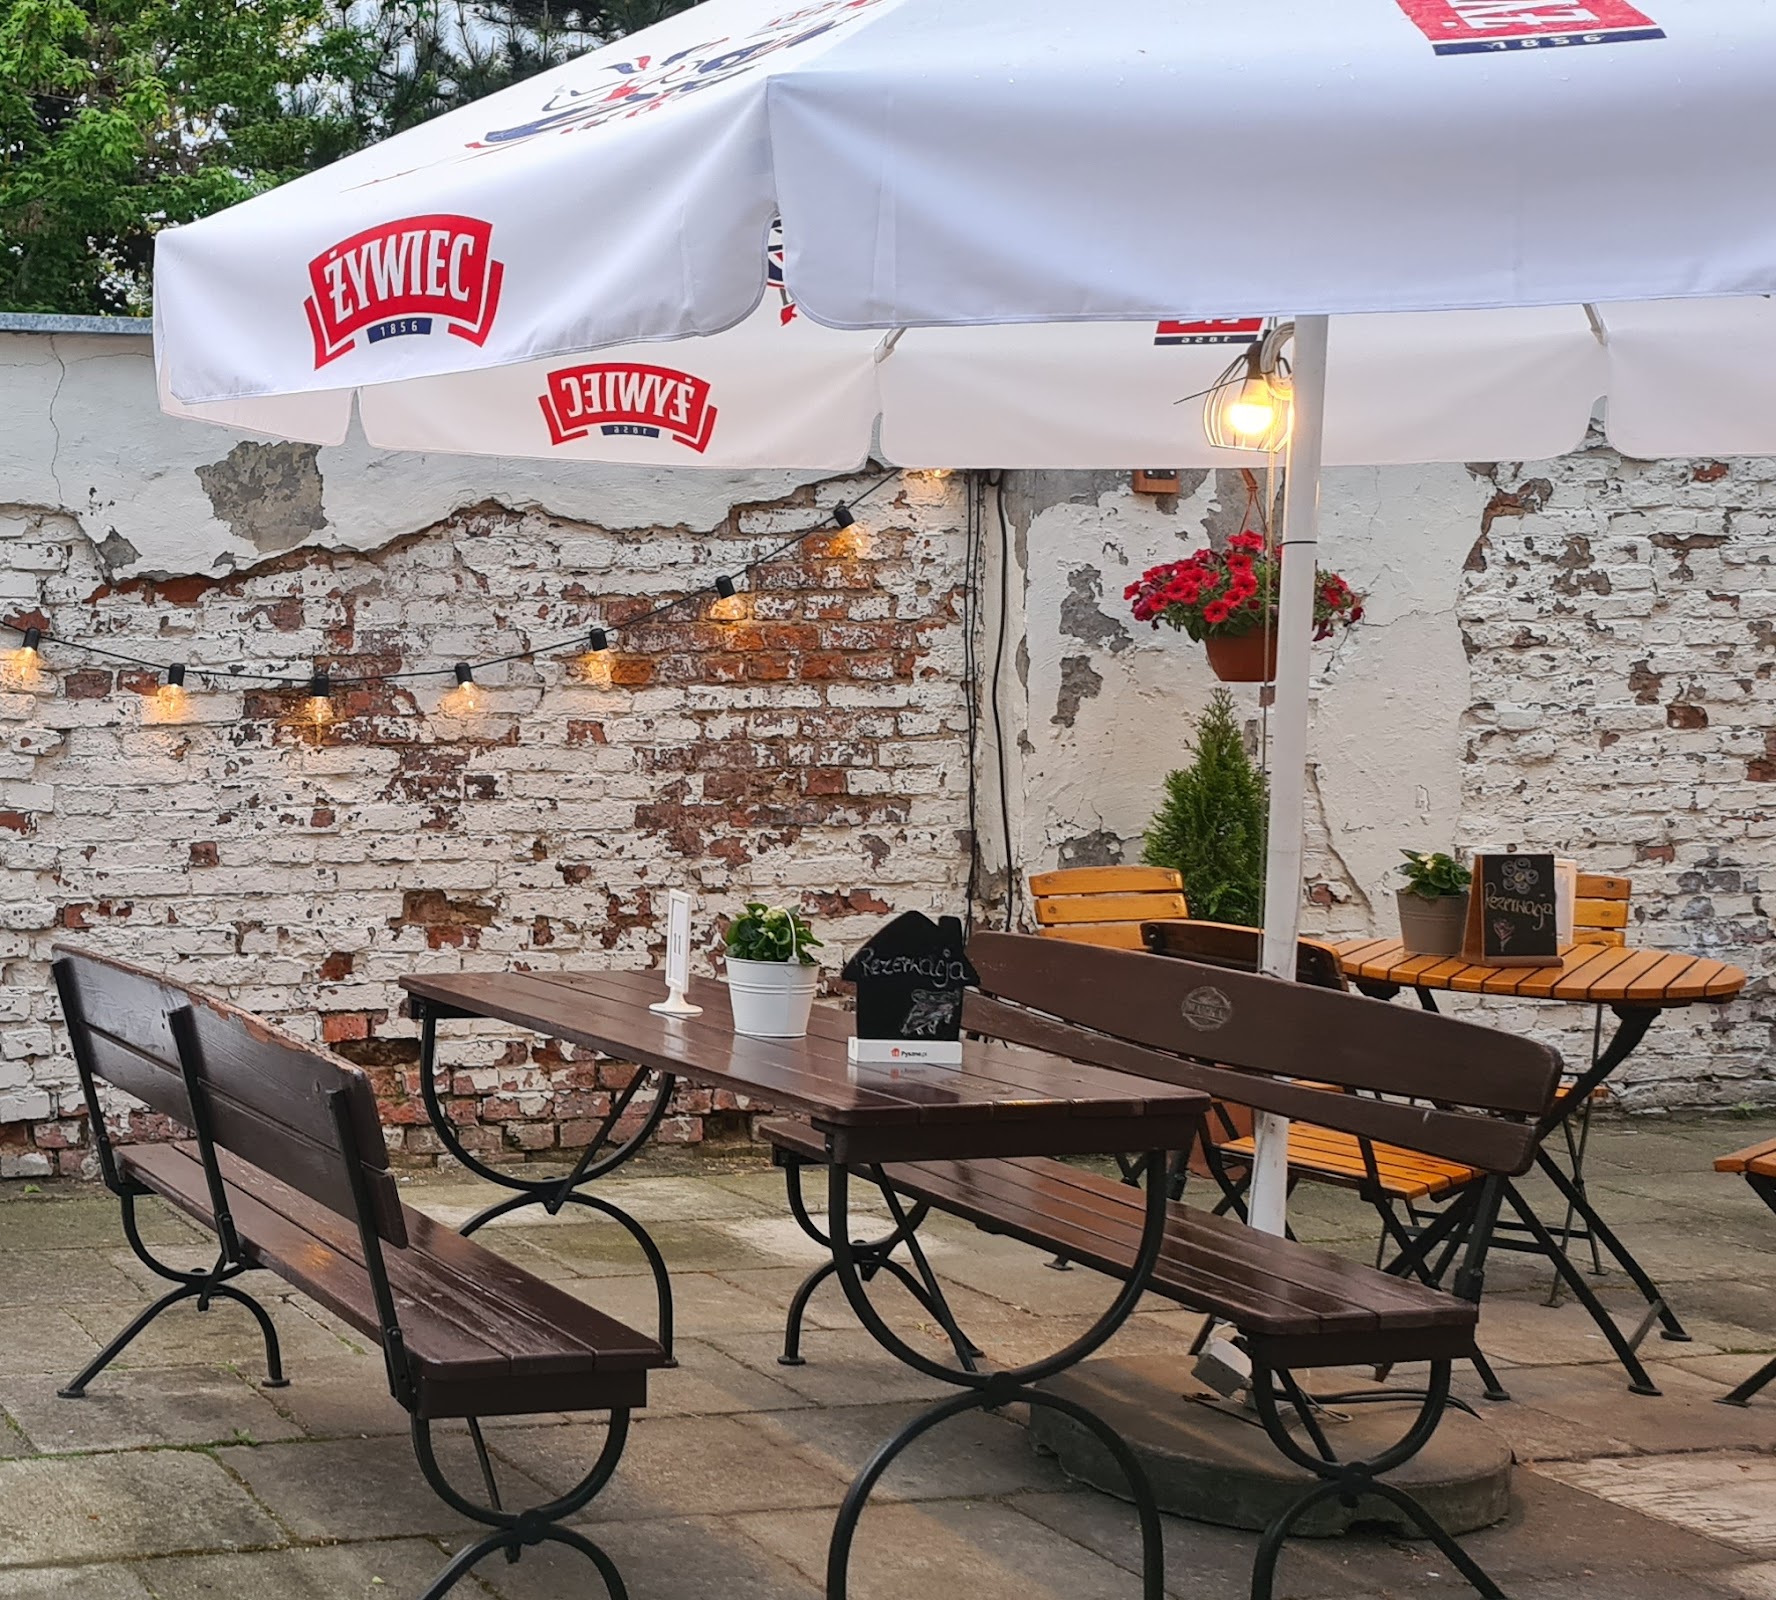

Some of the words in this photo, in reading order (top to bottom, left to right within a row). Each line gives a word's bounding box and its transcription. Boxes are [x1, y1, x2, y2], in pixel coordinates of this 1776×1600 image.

[1482, 35, 1606, 49] 1856
[324, 229, 475, 325] ŻYWIEC
[380, 320, 418, 337] 1856
